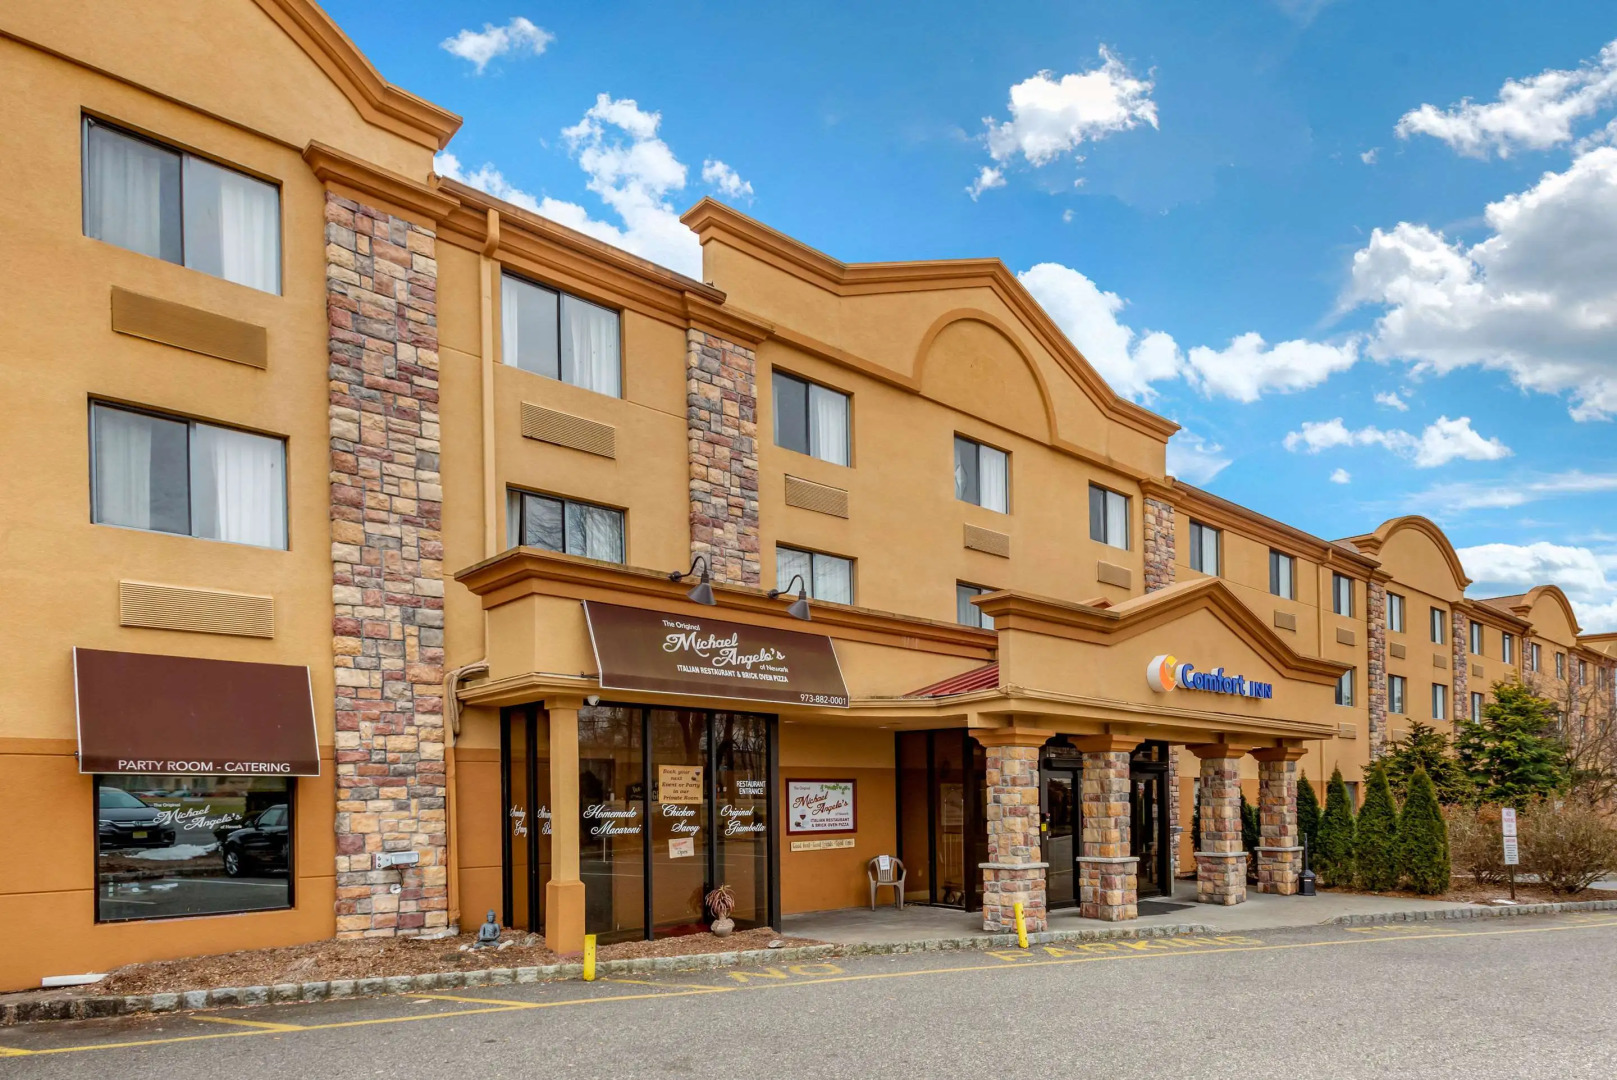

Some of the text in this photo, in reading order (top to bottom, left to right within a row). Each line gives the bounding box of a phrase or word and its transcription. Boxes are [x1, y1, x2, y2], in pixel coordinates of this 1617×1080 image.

[676, 622, 700, 630] Original
[662, 631, 738, 657] Michael
[712, 648, 785, 669] Angelo's
[676, 664, 700, 673] ITALIAN
[700, 667, 735, 677] RESTAURANT
[759, 673, 773, 681] OVEN
[766, 664, 789, 673] Newark
[1181, 663, 1272, 699] Comfort INN
[800, 694, 846, 705] 973-882-0001
[118, 760, 164, 770] PARTY
[167, 761, 213, 771] ROOM
[224, 762, 291, 772] CATERING
[793, 791, 829, 809] Michael
[812, 800, 848, 815] Angelo's
[153, 804, 210, 825] Michael
[583, 804, 637, 818] Homemade
[662, 804, 696, 817] Chicken
[721, 804, 755, 820] Original
[184, 813, 242, 830] Angelo's
[591, 820, 641, 835] Macaroni
[671, 819, 700, 836] Savoy
[728, 936, 1265, 982] NO PARKING
